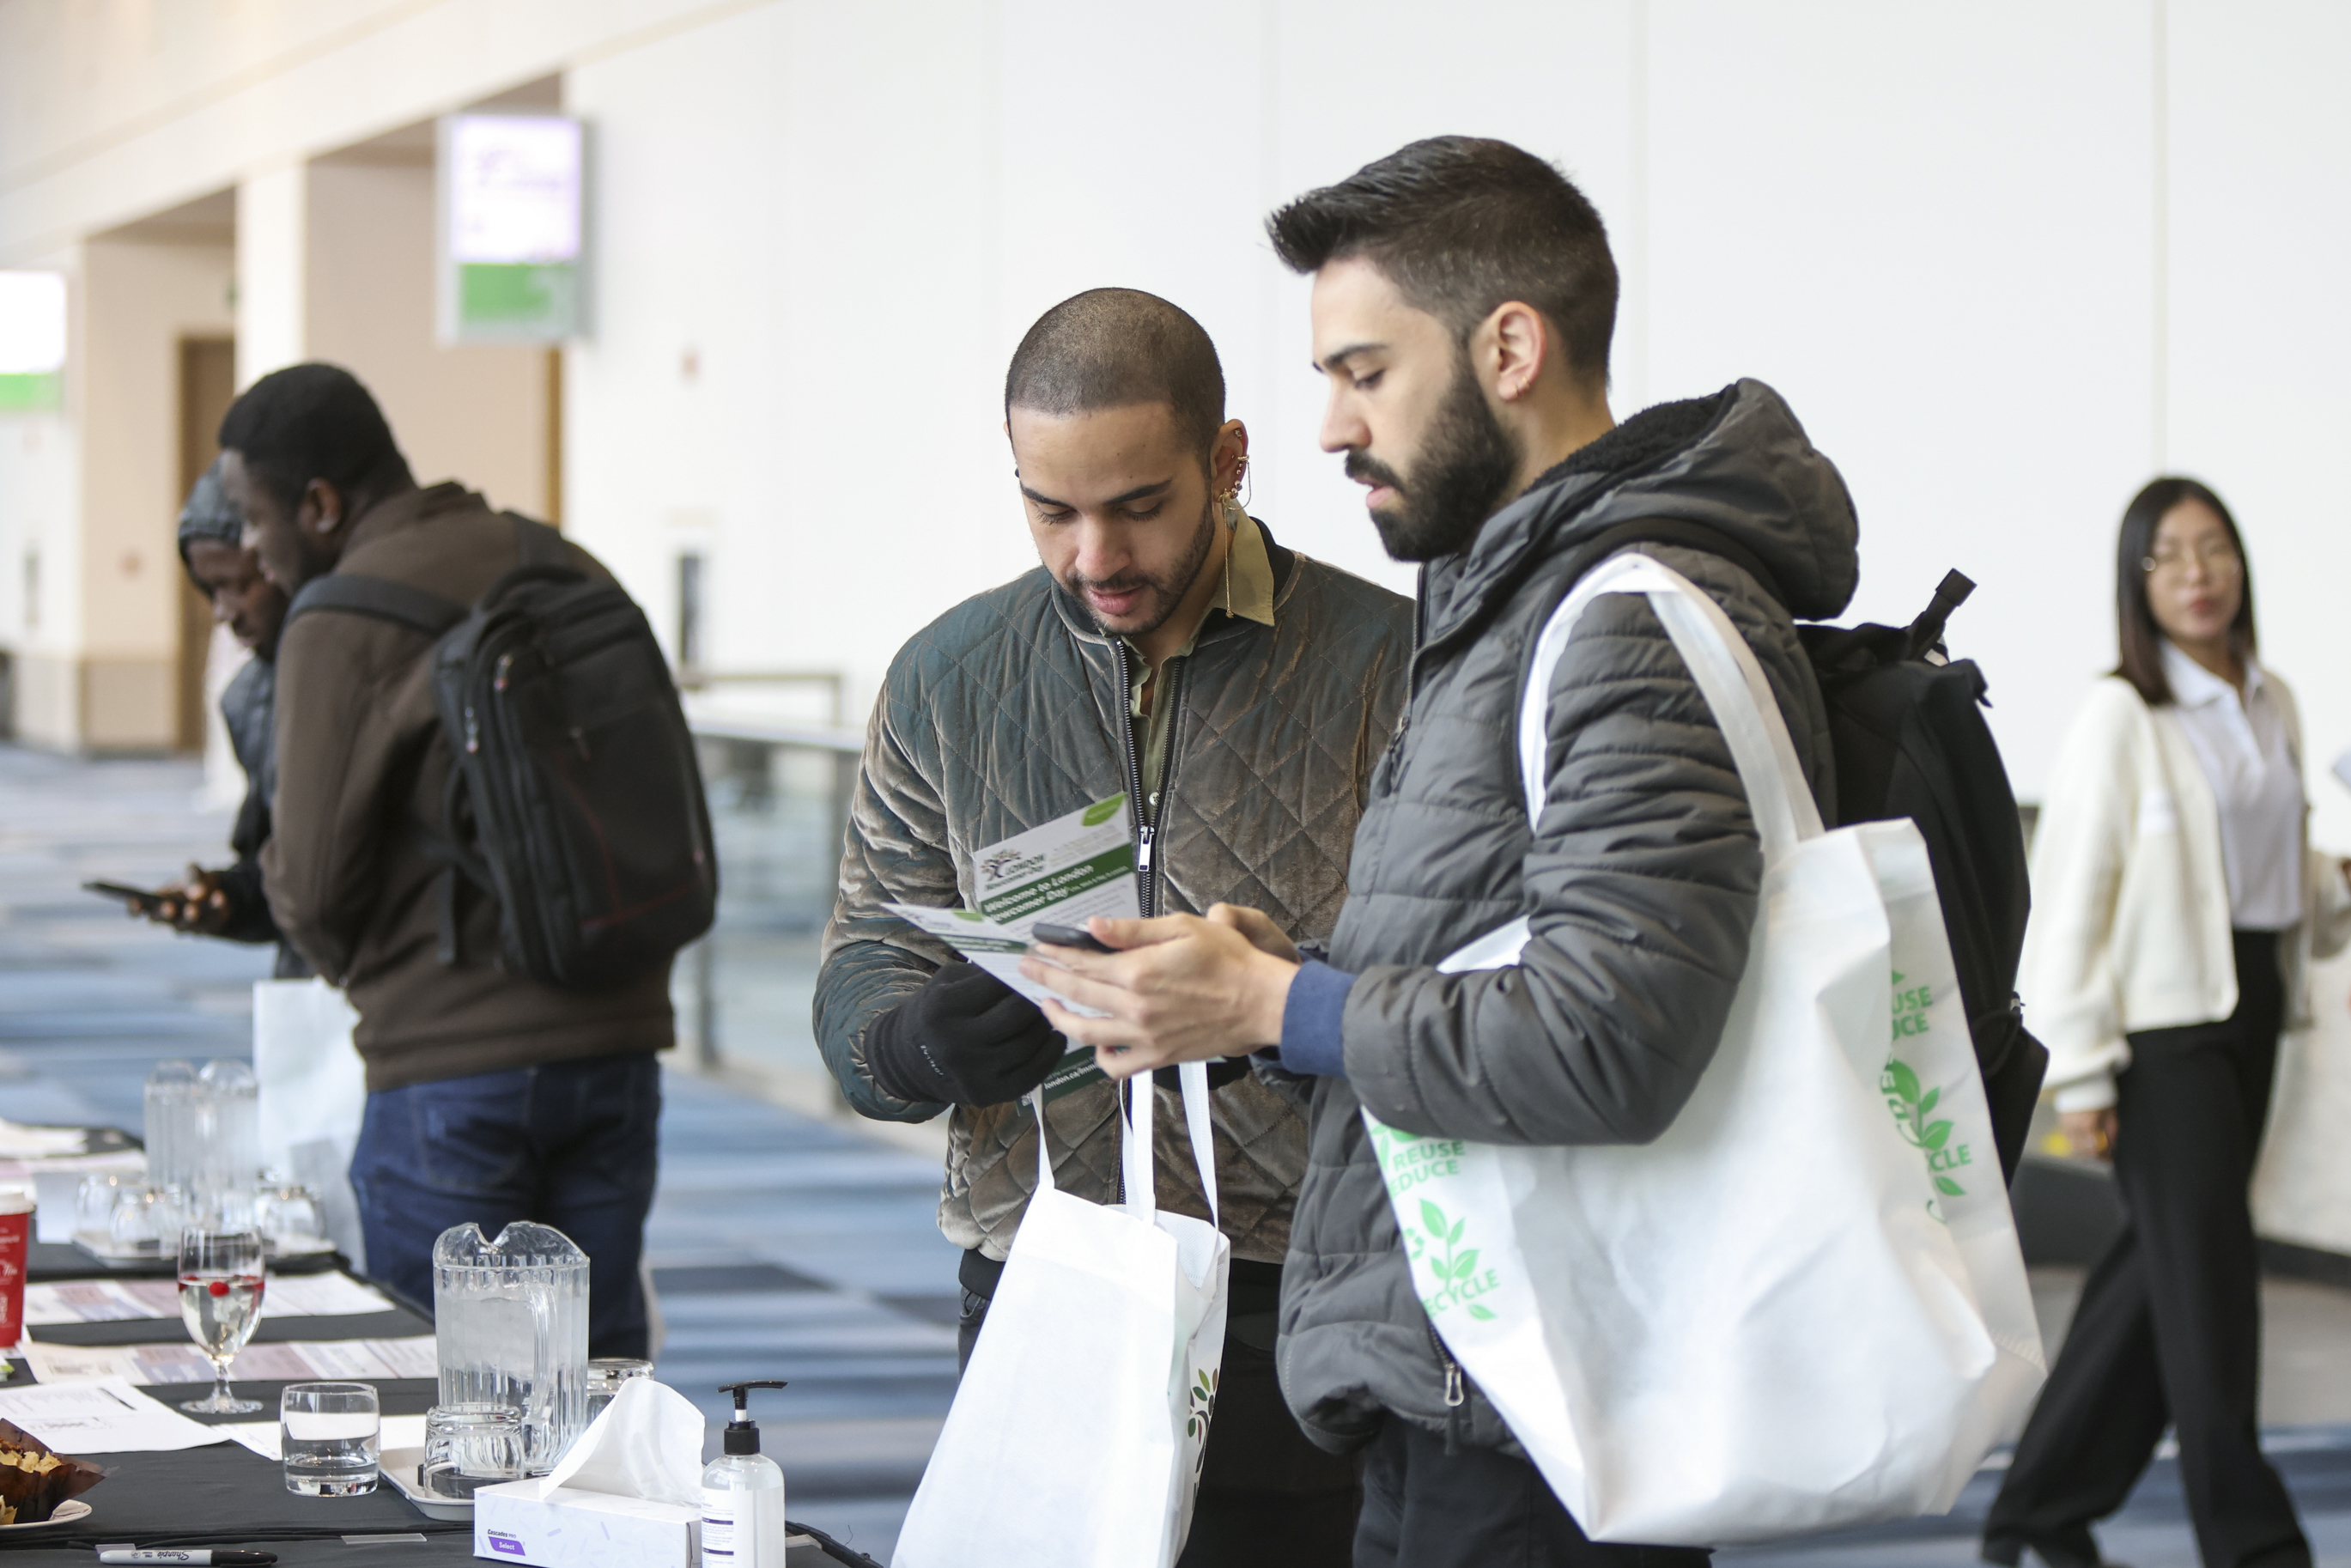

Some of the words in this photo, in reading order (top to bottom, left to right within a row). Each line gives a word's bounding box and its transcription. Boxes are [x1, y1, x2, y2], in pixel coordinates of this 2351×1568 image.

[984, 888, 1037, 912] Welcome
[1037, 882, 1052, 893] to
[1051, 865, 1095, 887] London
[1393, 1140, 1467, 1171] REUSE
[1388, 1159, 1461, 1199] EDUCE
[1423, 1268, 1500, 1320] ECYCLE
[488, 1528, 508, 1537] Cascades
[499, 1541, 515, 1551] Select
[156, 1551, 190, 1561] Sharpie
